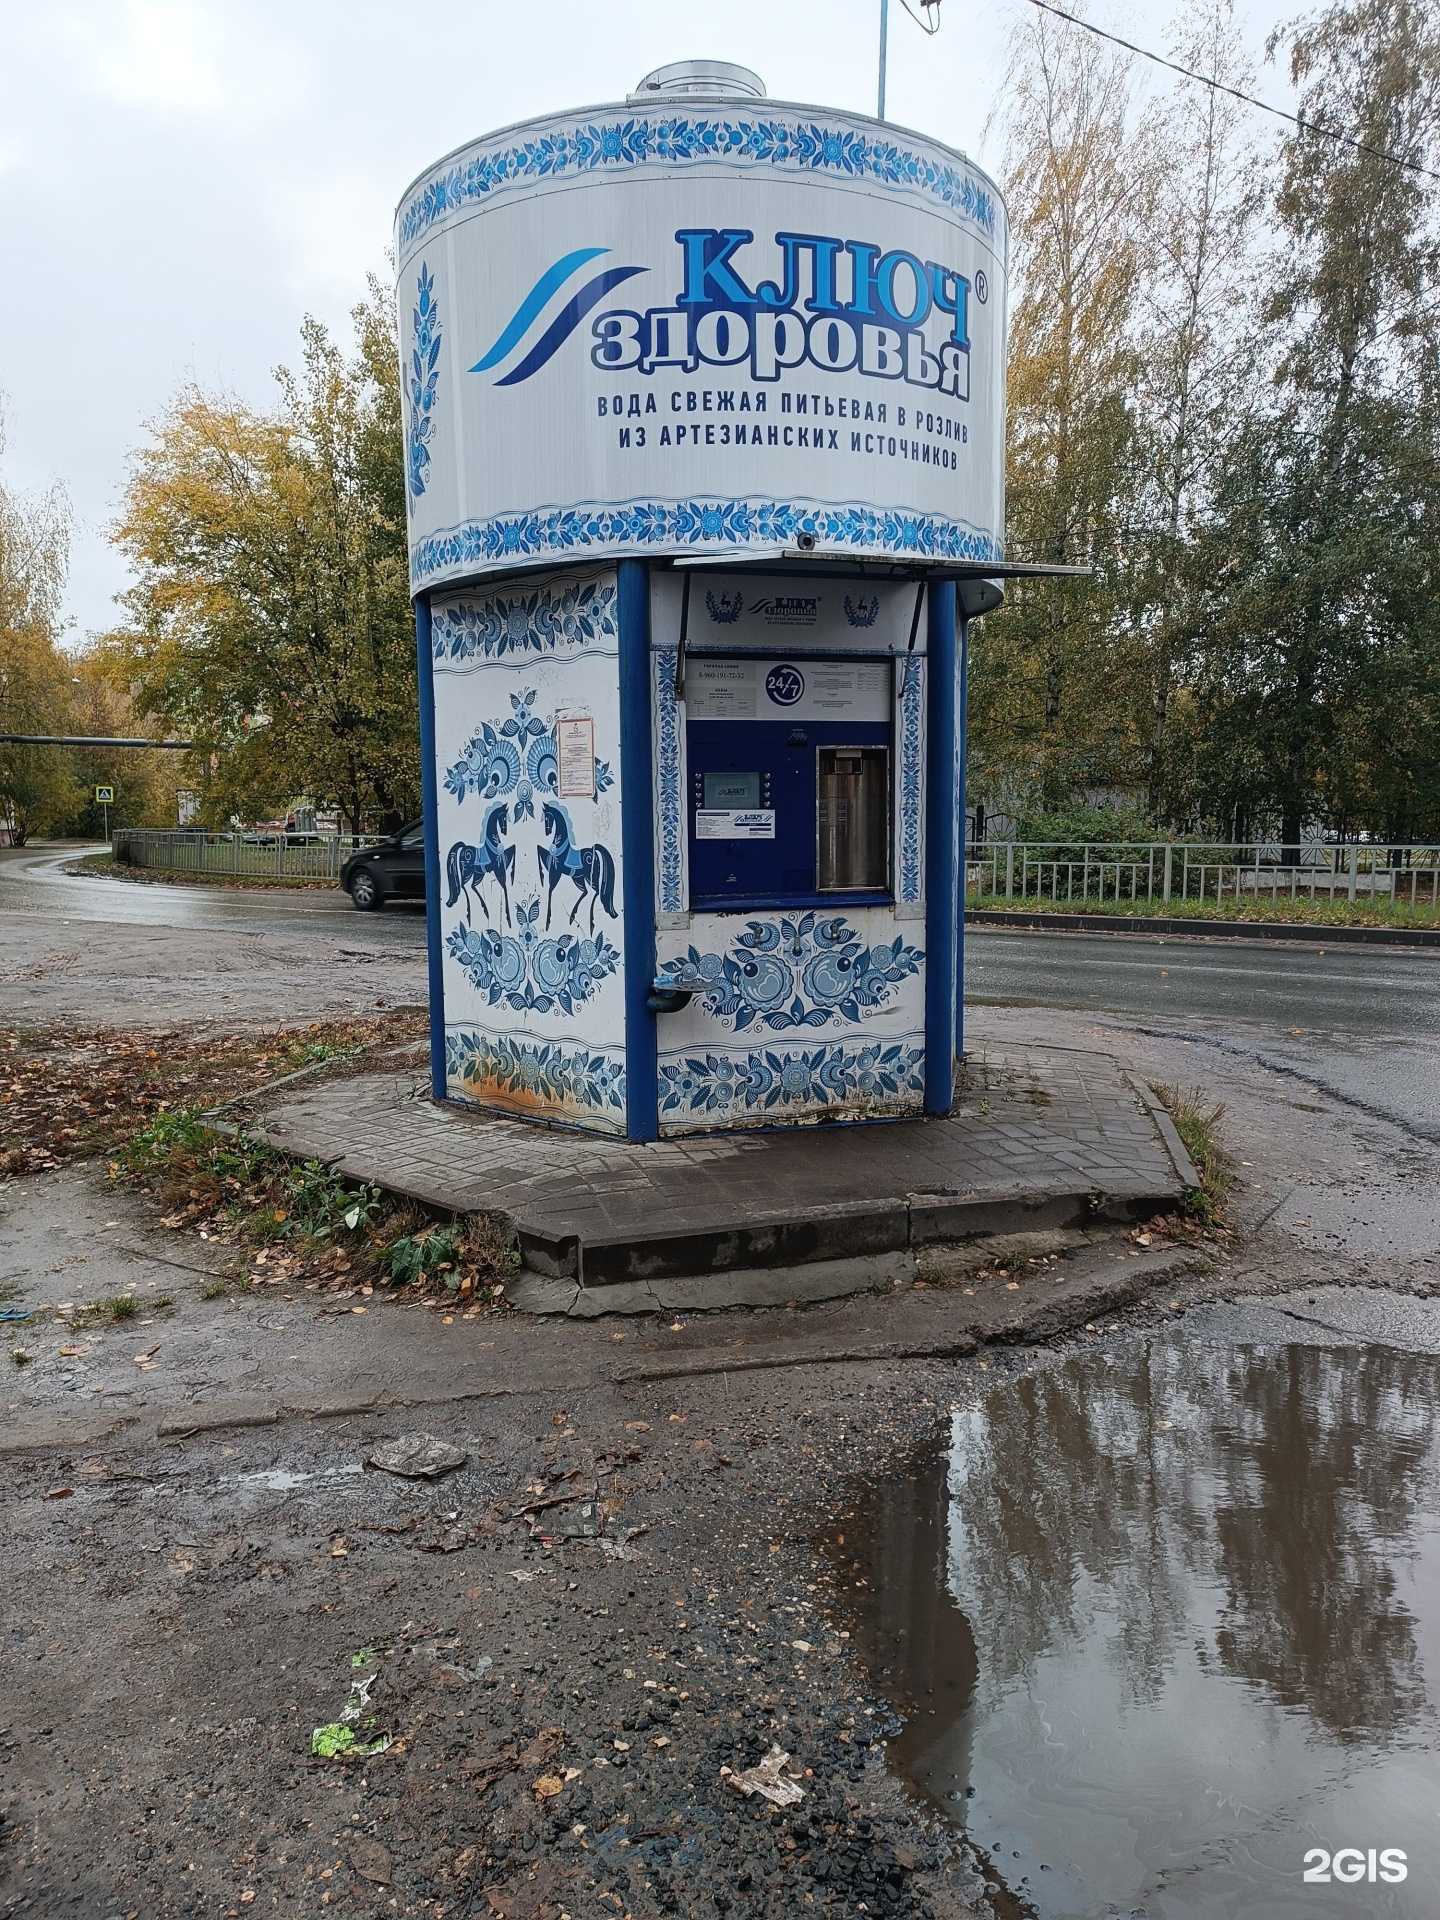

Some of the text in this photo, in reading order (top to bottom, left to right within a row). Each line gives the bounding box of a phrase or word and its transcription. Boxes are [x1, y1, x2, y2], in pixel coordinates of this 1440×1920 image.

[675, 228, 971, 346] КЛЮЧ
[591, 306, 971, 402] здоровья
[597, 390, 968, 444] ВОДА СВЕЖАЯ ПИТЬЕВАЯ В РОЗЛИВ
[619, 424, 957, 471] ИЗ АРТЕЗИАНСКИХ ИСТОЧНИКОВ
